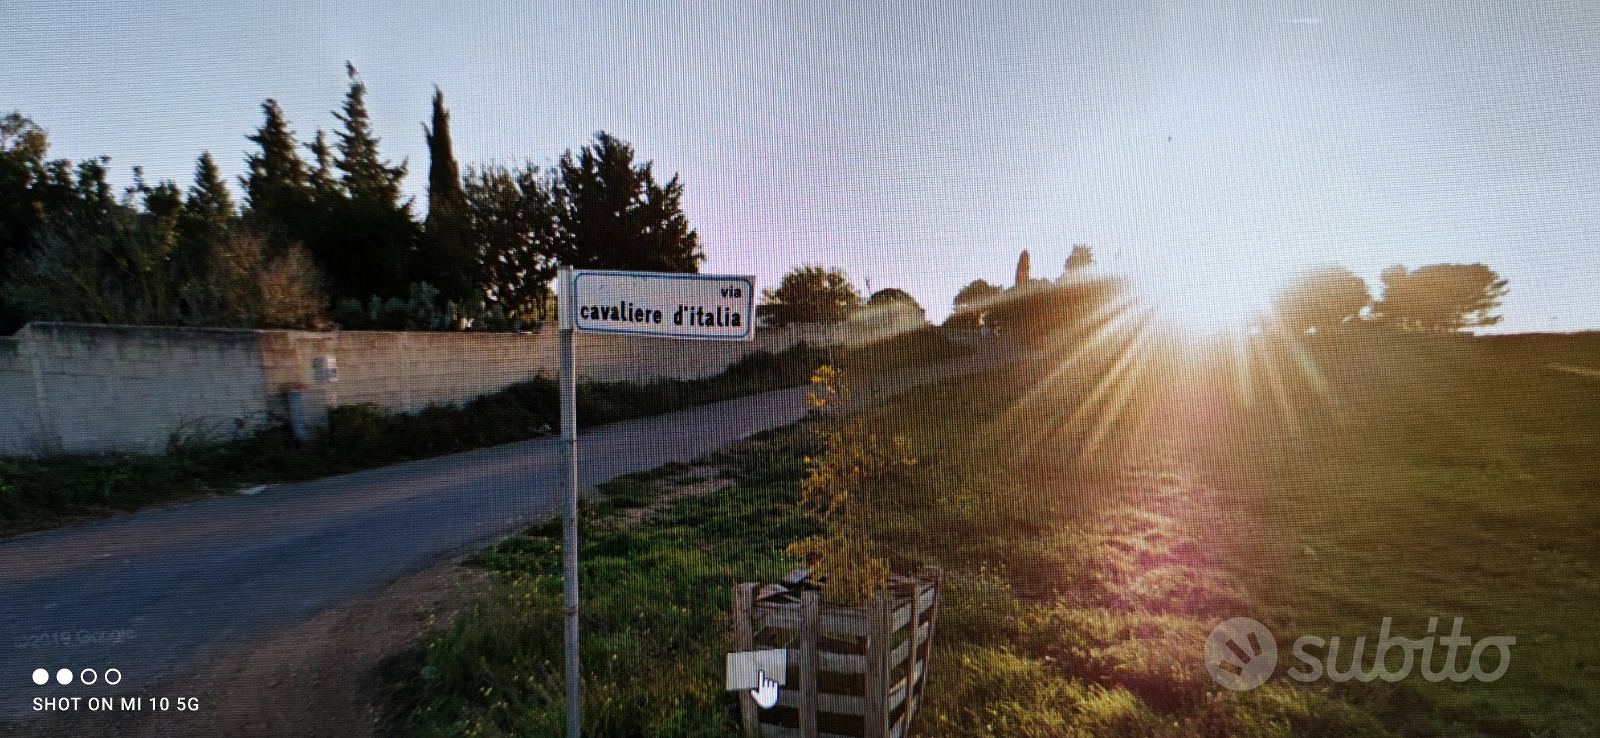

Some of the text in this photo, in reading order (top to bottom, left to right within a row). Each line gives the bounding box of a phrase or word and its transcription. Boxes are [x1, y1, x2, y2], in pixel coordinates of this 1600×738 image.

[720, 285, 742, 298] via
[580, 300, 741, 327] cavaliere d'italia
